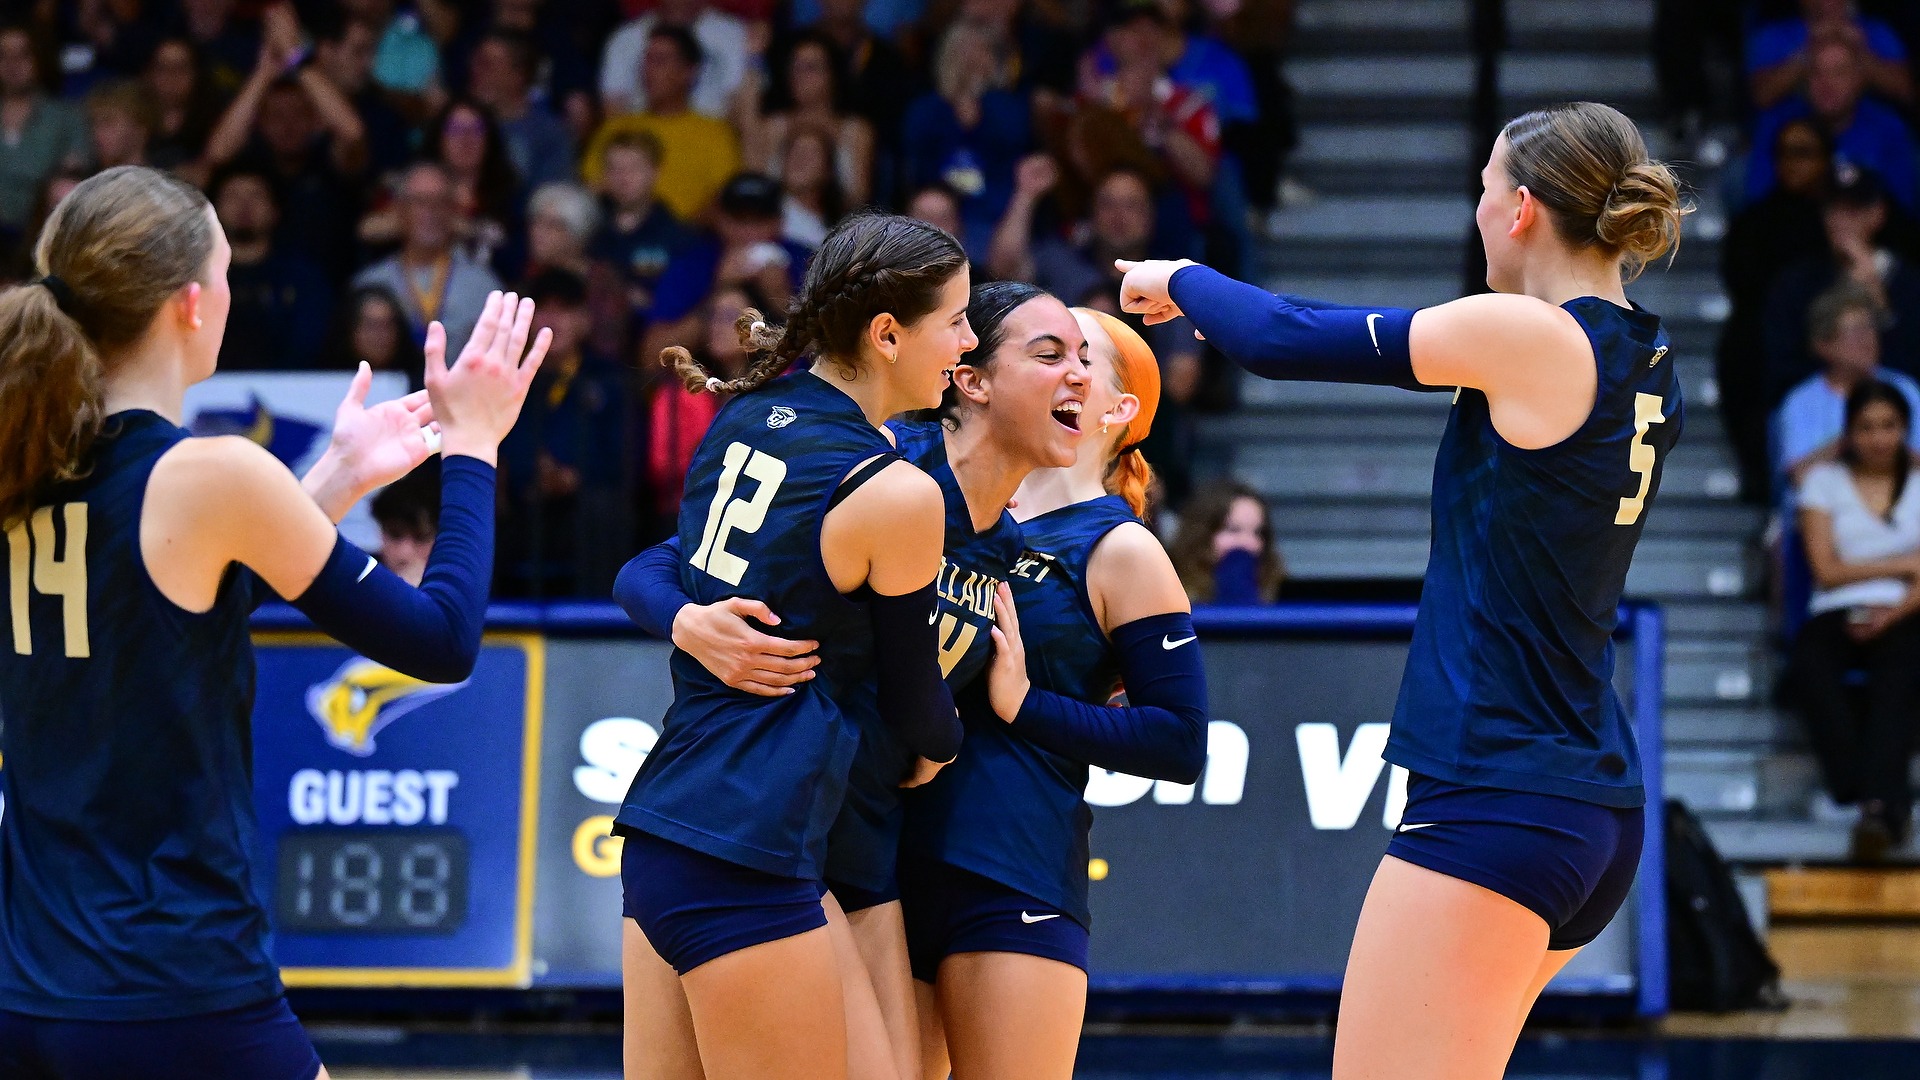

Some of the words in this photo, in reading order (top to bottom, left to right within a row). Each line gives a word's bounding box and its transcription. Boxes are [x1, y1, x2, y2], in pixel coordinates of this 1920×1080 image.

[688, 441, 788, 587] 12
[1614, 391, 1666, 526] 5
[7, 501, 91, 658] 14
[288, 768, 460, 826] GUEST
